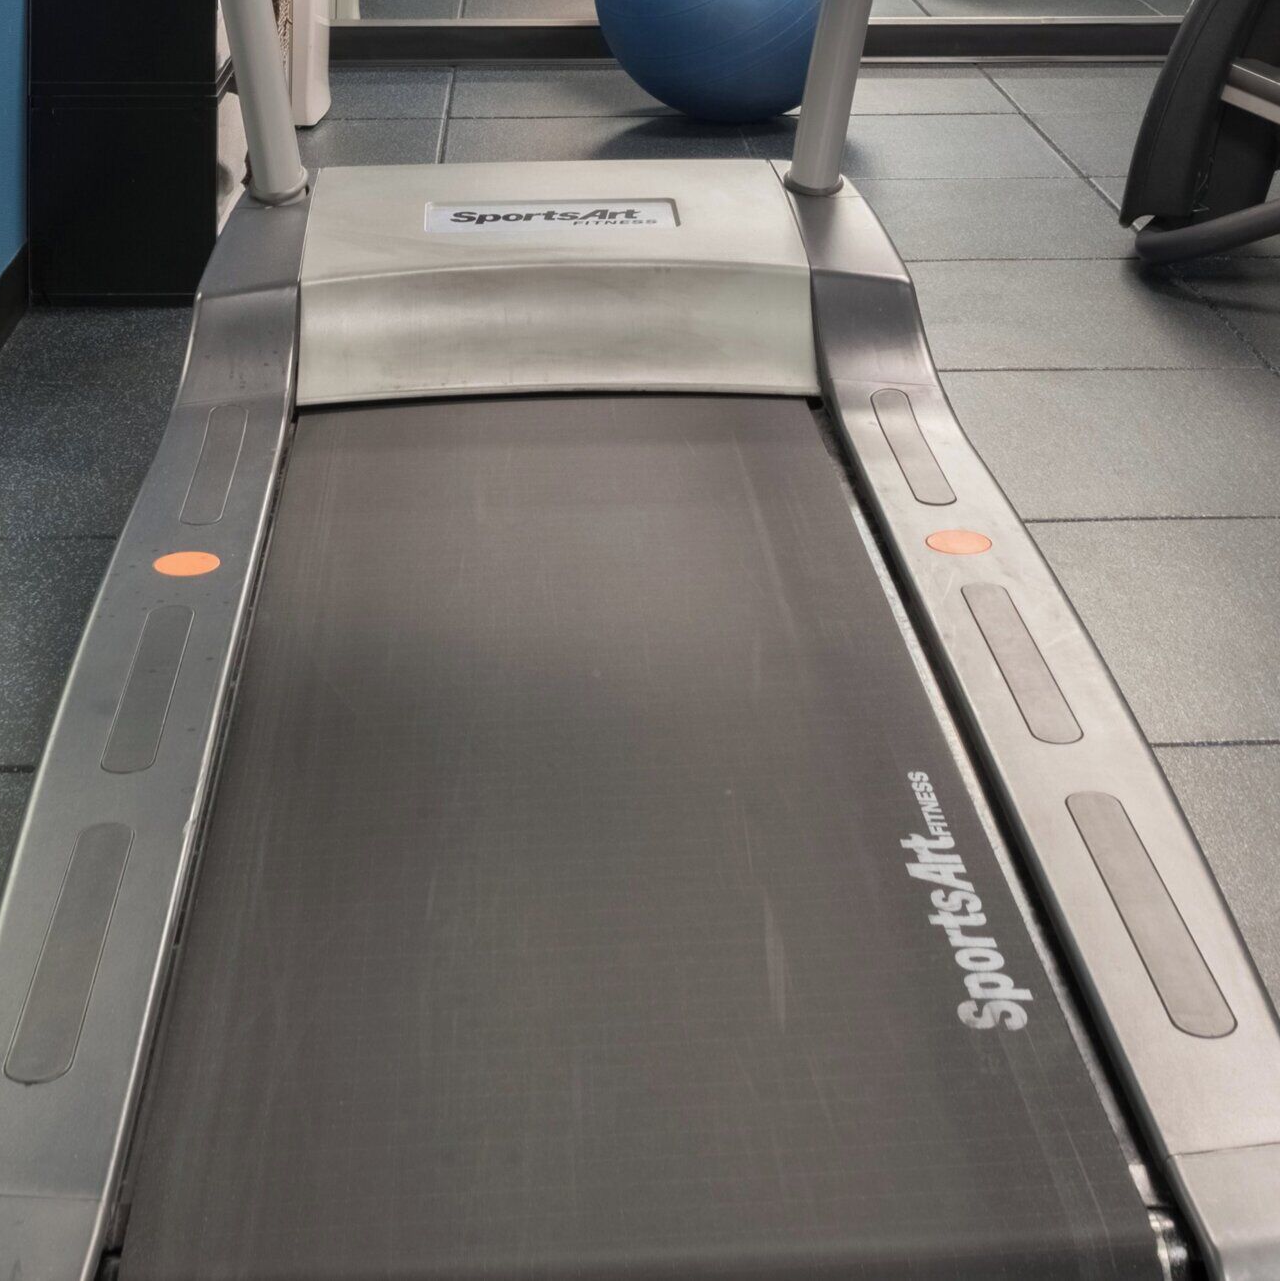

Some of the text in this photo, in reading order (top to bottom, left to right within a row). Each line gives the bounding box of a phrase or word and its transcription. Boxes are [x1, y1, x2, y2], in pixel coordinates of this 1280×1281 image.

[450, 208, 658, 226] SportsArt FITNESS
[899, 770, 1034, 1031] SportsArt FITNESS
